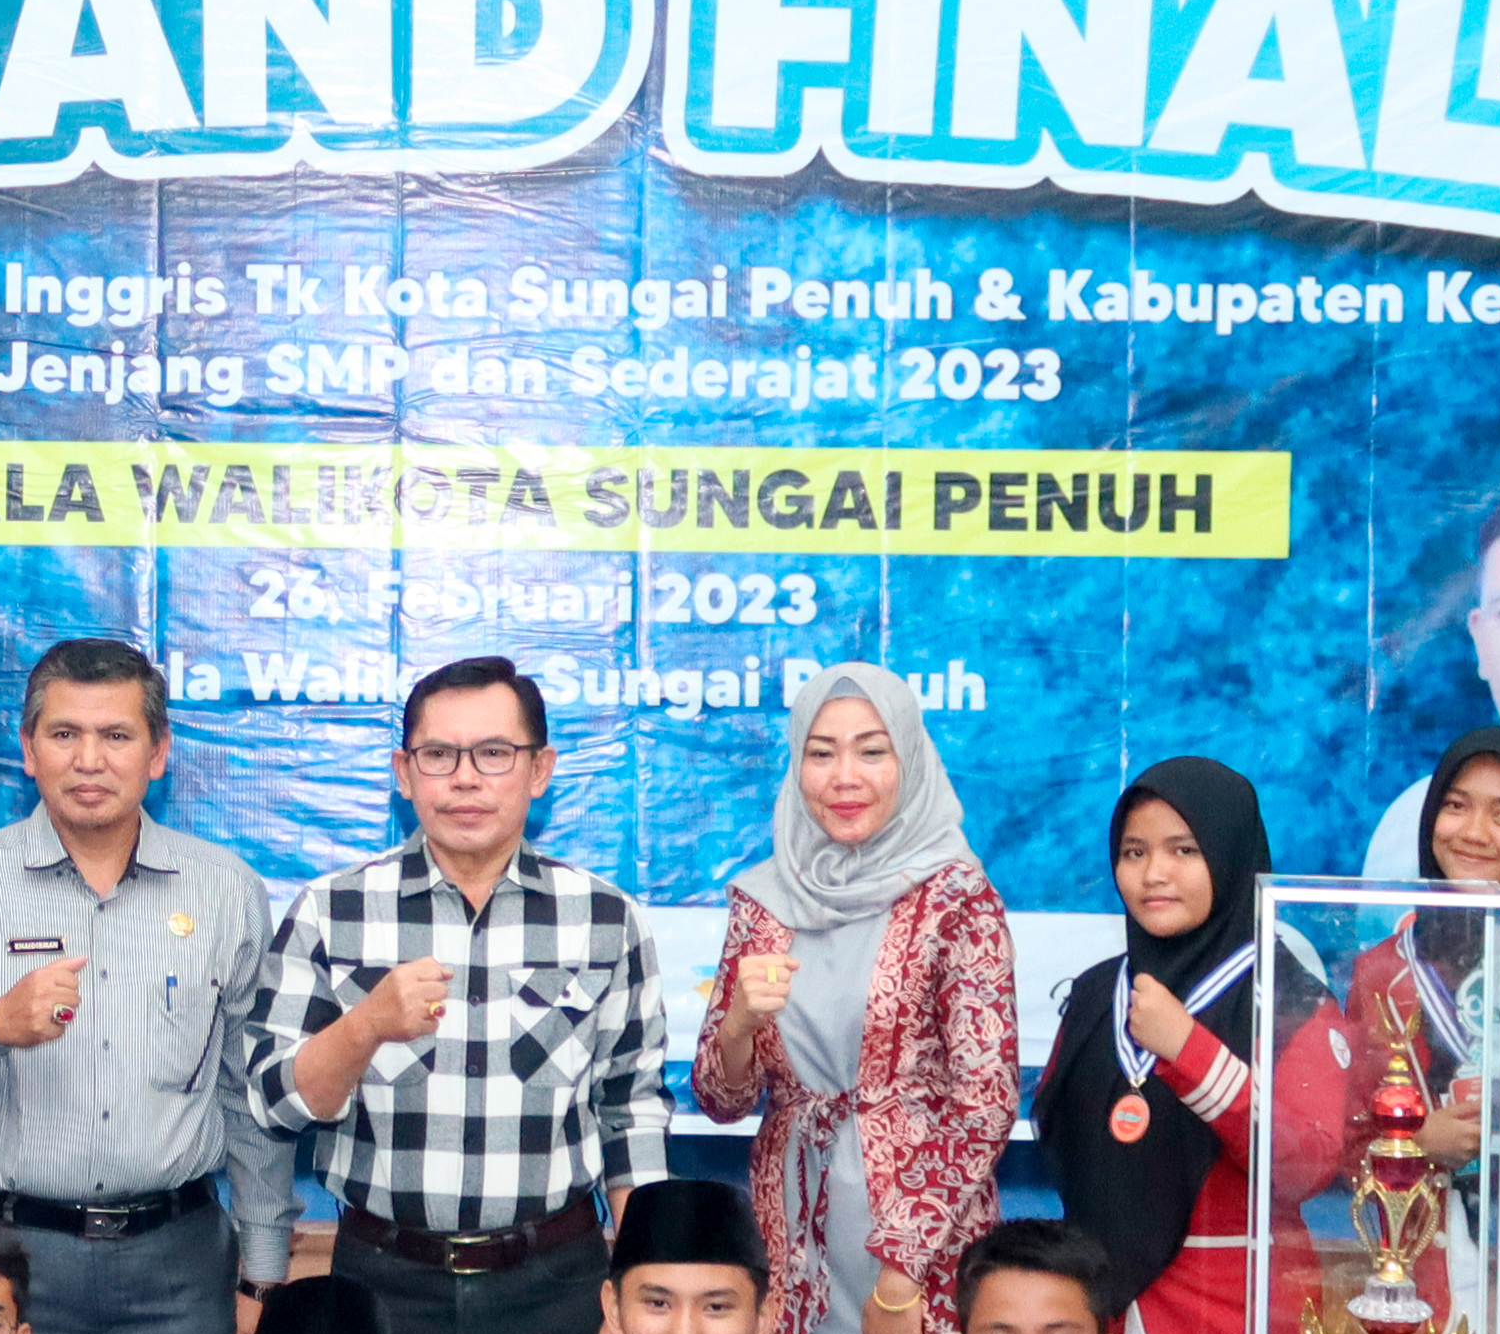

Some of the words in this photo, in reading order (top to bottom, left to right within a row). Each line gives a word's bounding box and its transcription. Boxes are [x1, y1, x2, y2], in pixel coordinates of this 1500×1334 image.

[5, 263, 227, 328] Inggris
[245, 264, 320, 316] Tk
[342, 264, 487, 318] Kota
[509, 268, 729, 334] Sungai
[749, 268, 955, 322] Penuh
[974, 269, 1029, 323] &
[1047, 269, 1403, 337] Kabupaten
[263, 343, 410, 397] SMP
[430, 347, 550, 400] dan
[568, 347, 877, 407] Sederajat
[898, 349, 1063, 403] 2023
[128, 462, 557, 529] WALIKOTA
[583, 467, 905, 532] SUNGAI
[932, 470, 1216, 535] PENUH
[367, 569, 634, 624] Februari
[655, 571, 817, 625] 2023
[545, 653, 759, 721] Sungai
[782, 657, 987, 711] Puh
